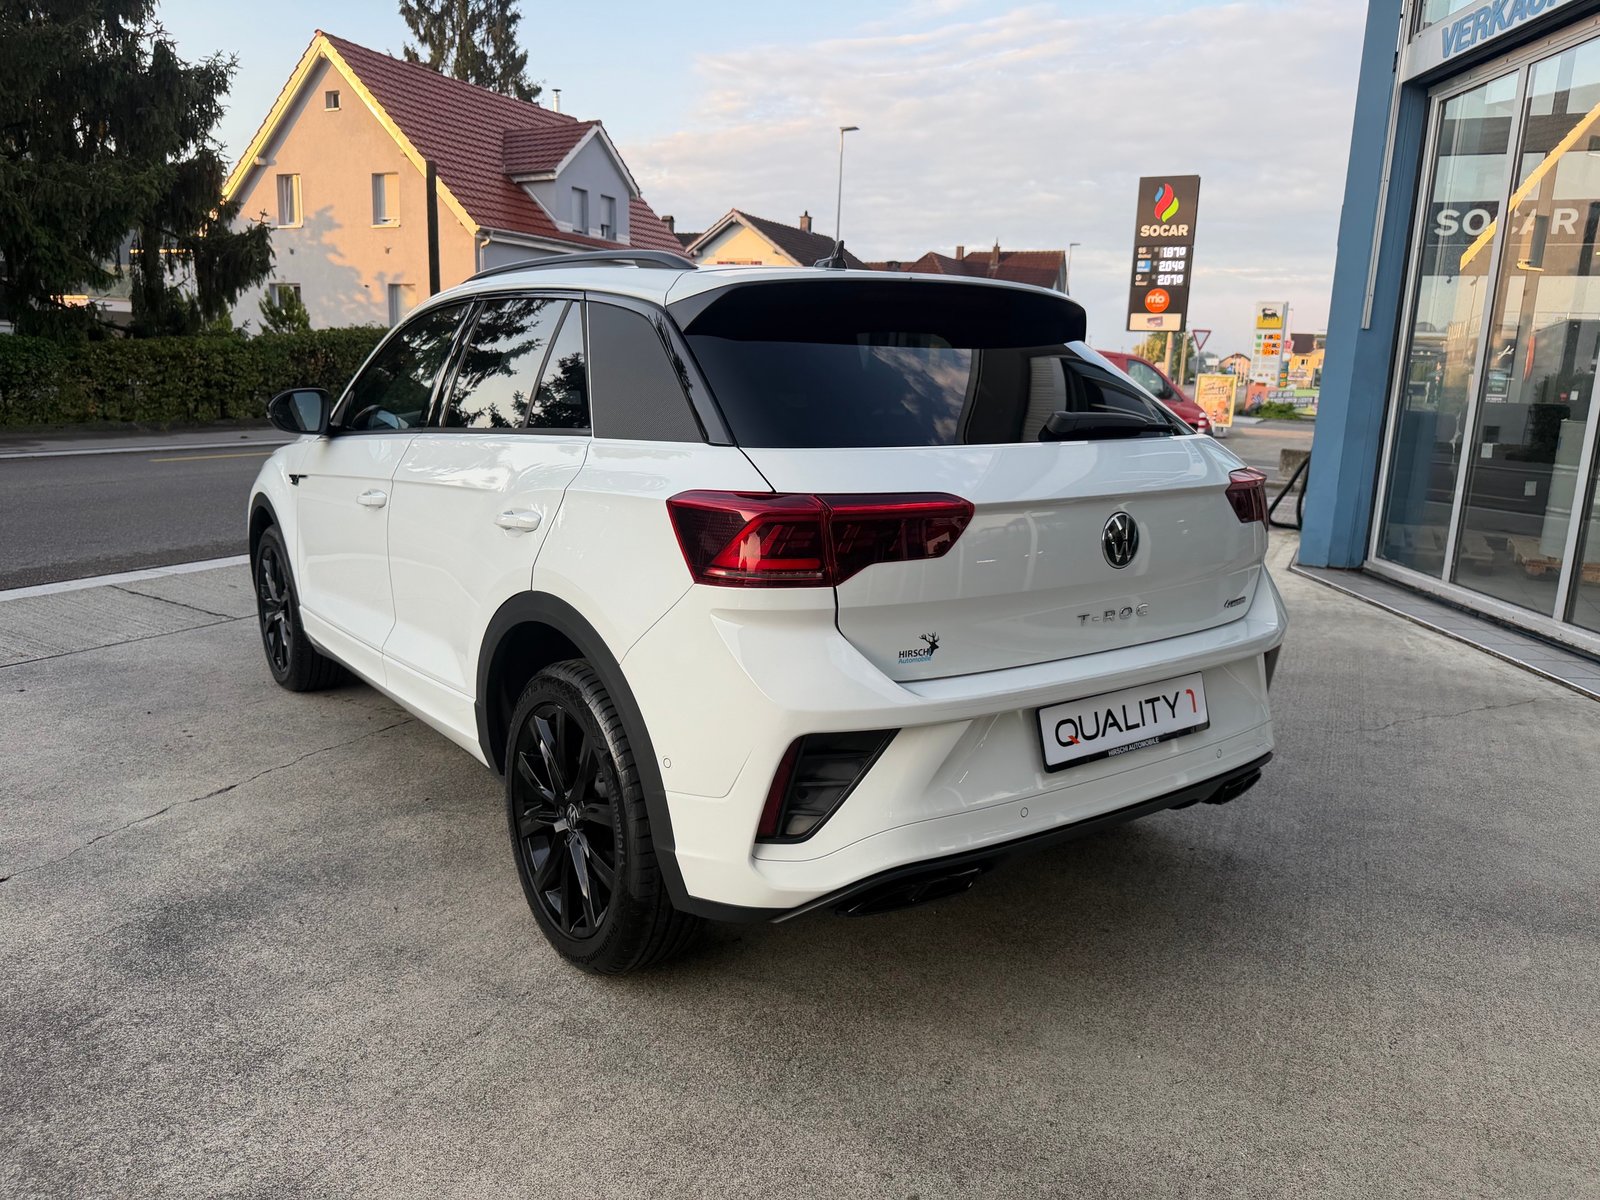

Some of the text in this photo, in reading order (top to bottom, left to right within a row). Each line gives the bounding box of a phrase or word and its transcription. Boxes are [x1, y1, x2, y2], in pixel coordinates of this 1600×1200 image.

[1441, 0, 1556, 59] VERKAU
[1140, 224, 1189, 237] SOCAR
[1076, 602, 1149, 627] T-ROC
[1054, 688, 1197, 748] QUALITY 1
